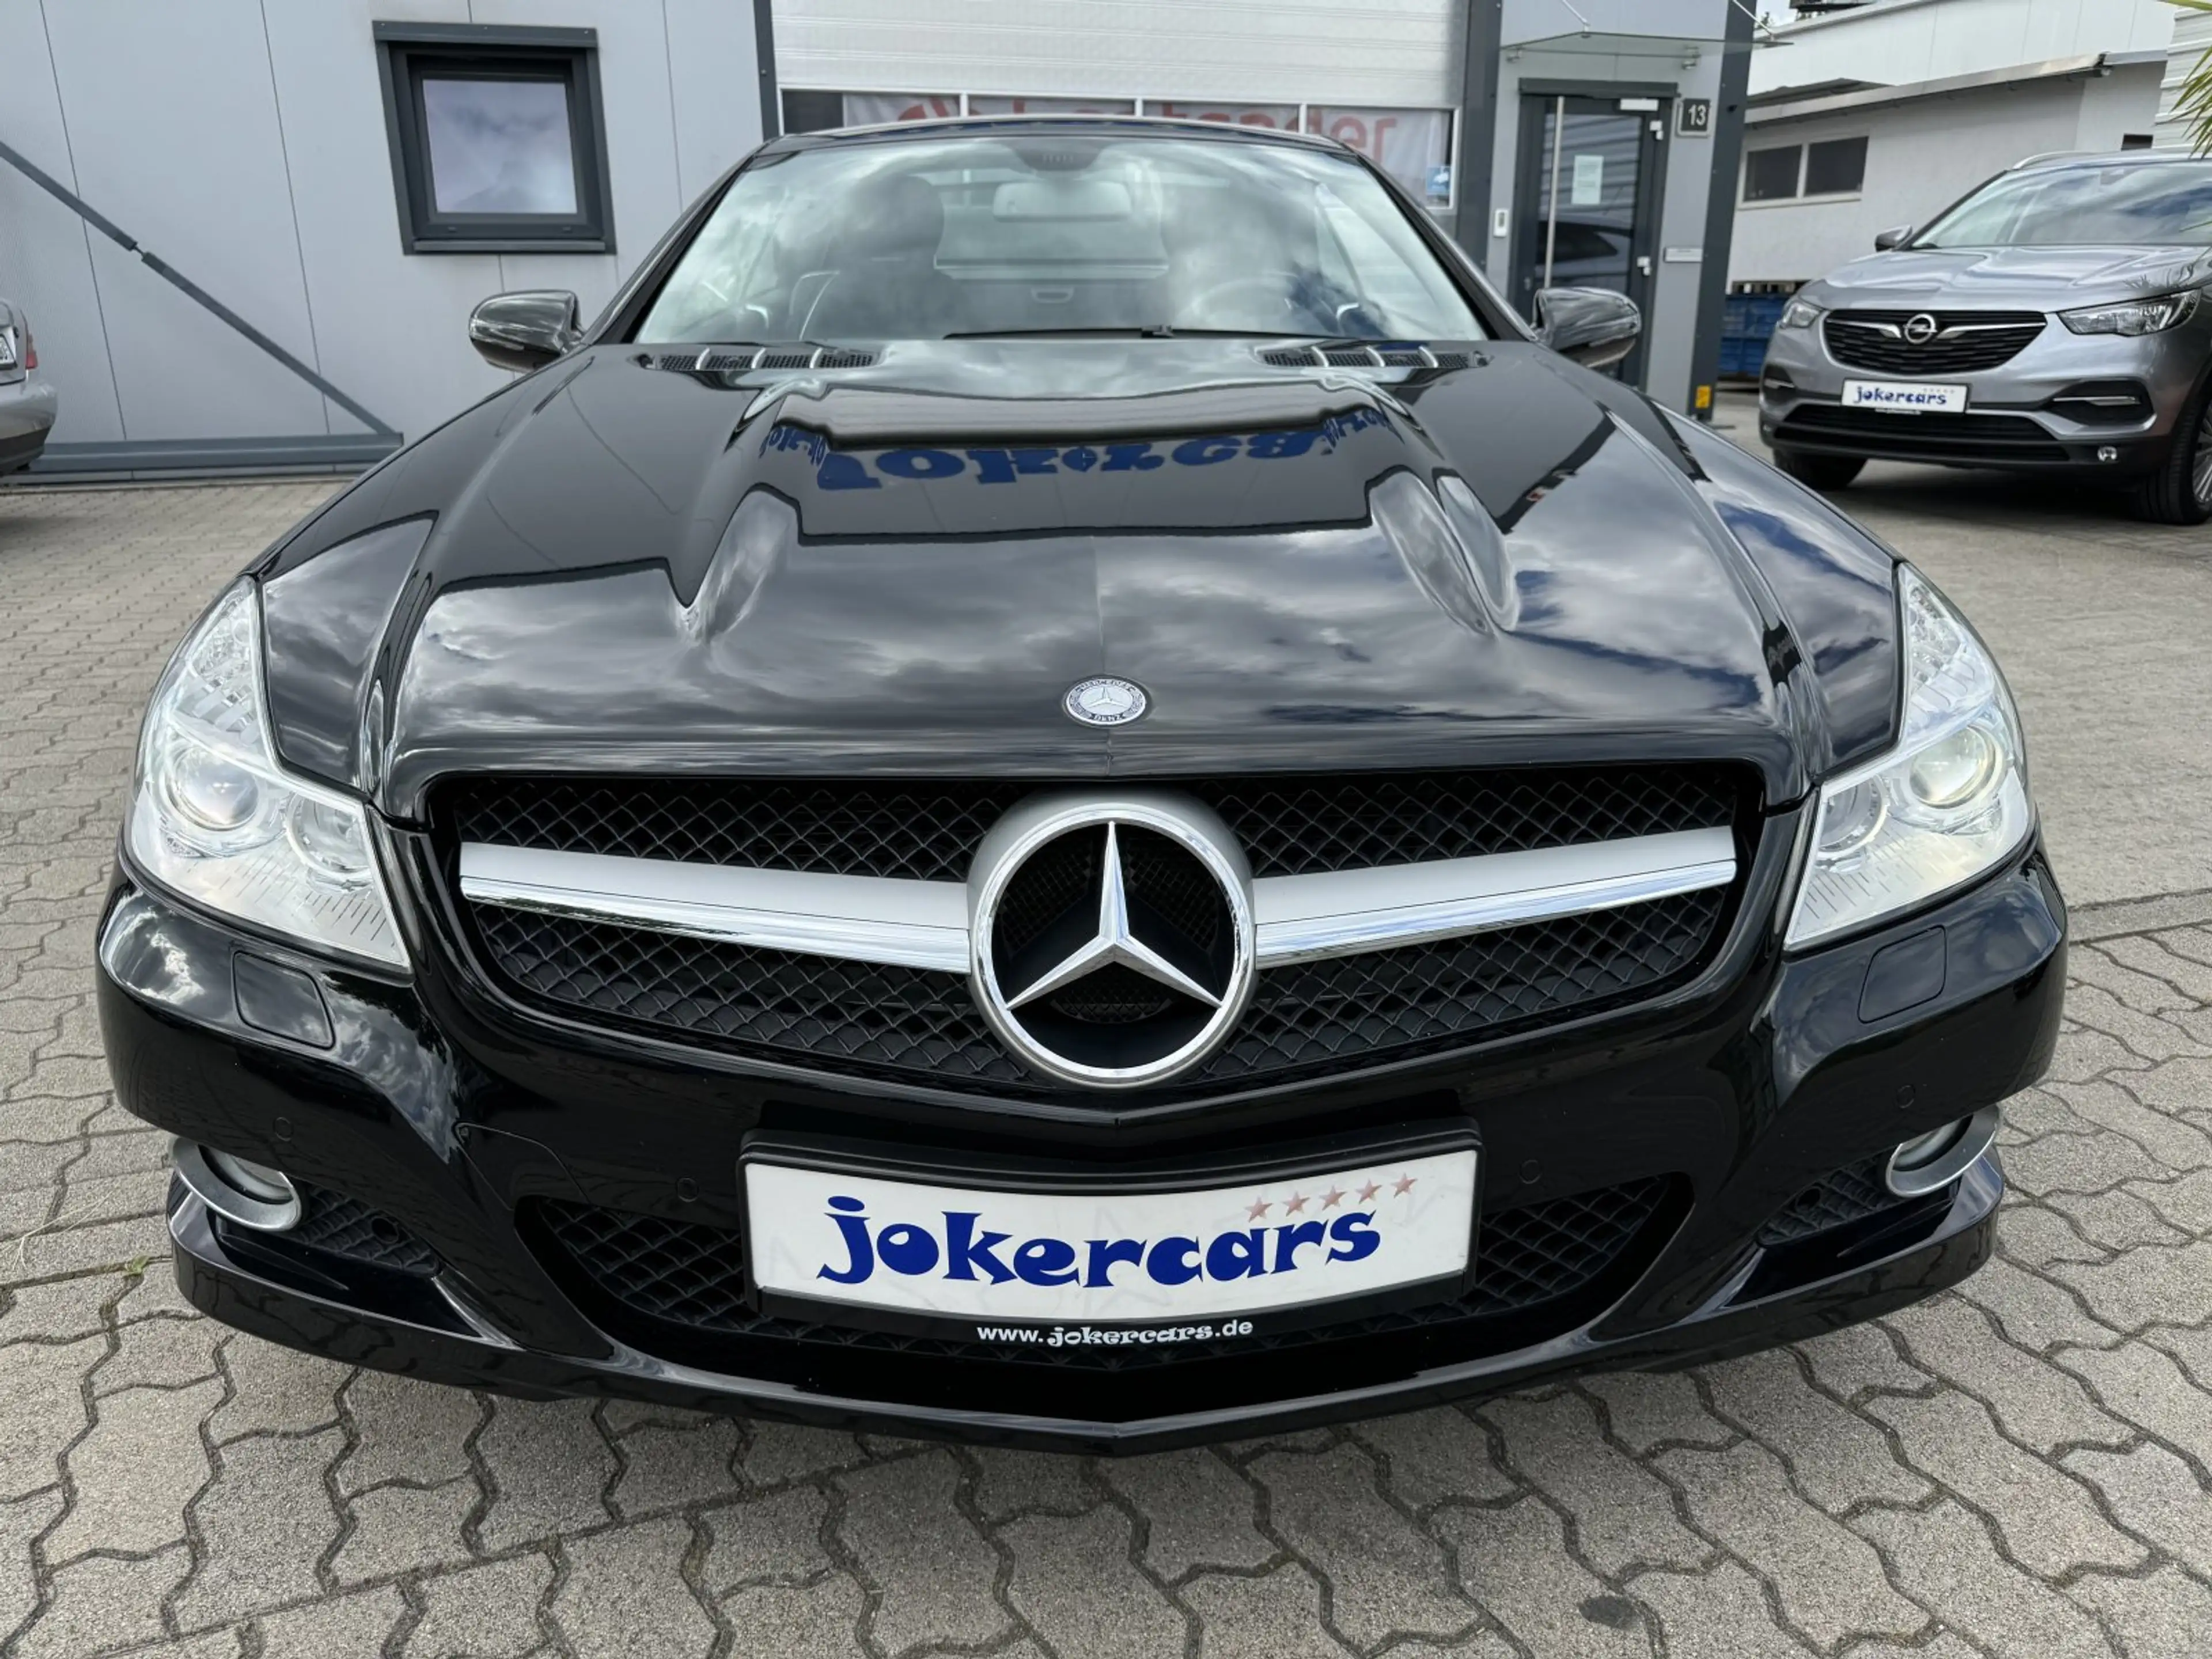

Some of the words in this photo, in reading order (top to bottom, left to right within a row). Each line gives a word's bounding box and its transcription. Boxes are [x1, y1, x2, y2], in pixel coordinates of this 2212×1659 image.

[1687, 104, 1706, 126] 13
[1854, 386, 1947, 406] jokercars
[817, 1196, 1381, 1288] jokercars
[977, 1321, 1254, 1347] www.jokercars.de
